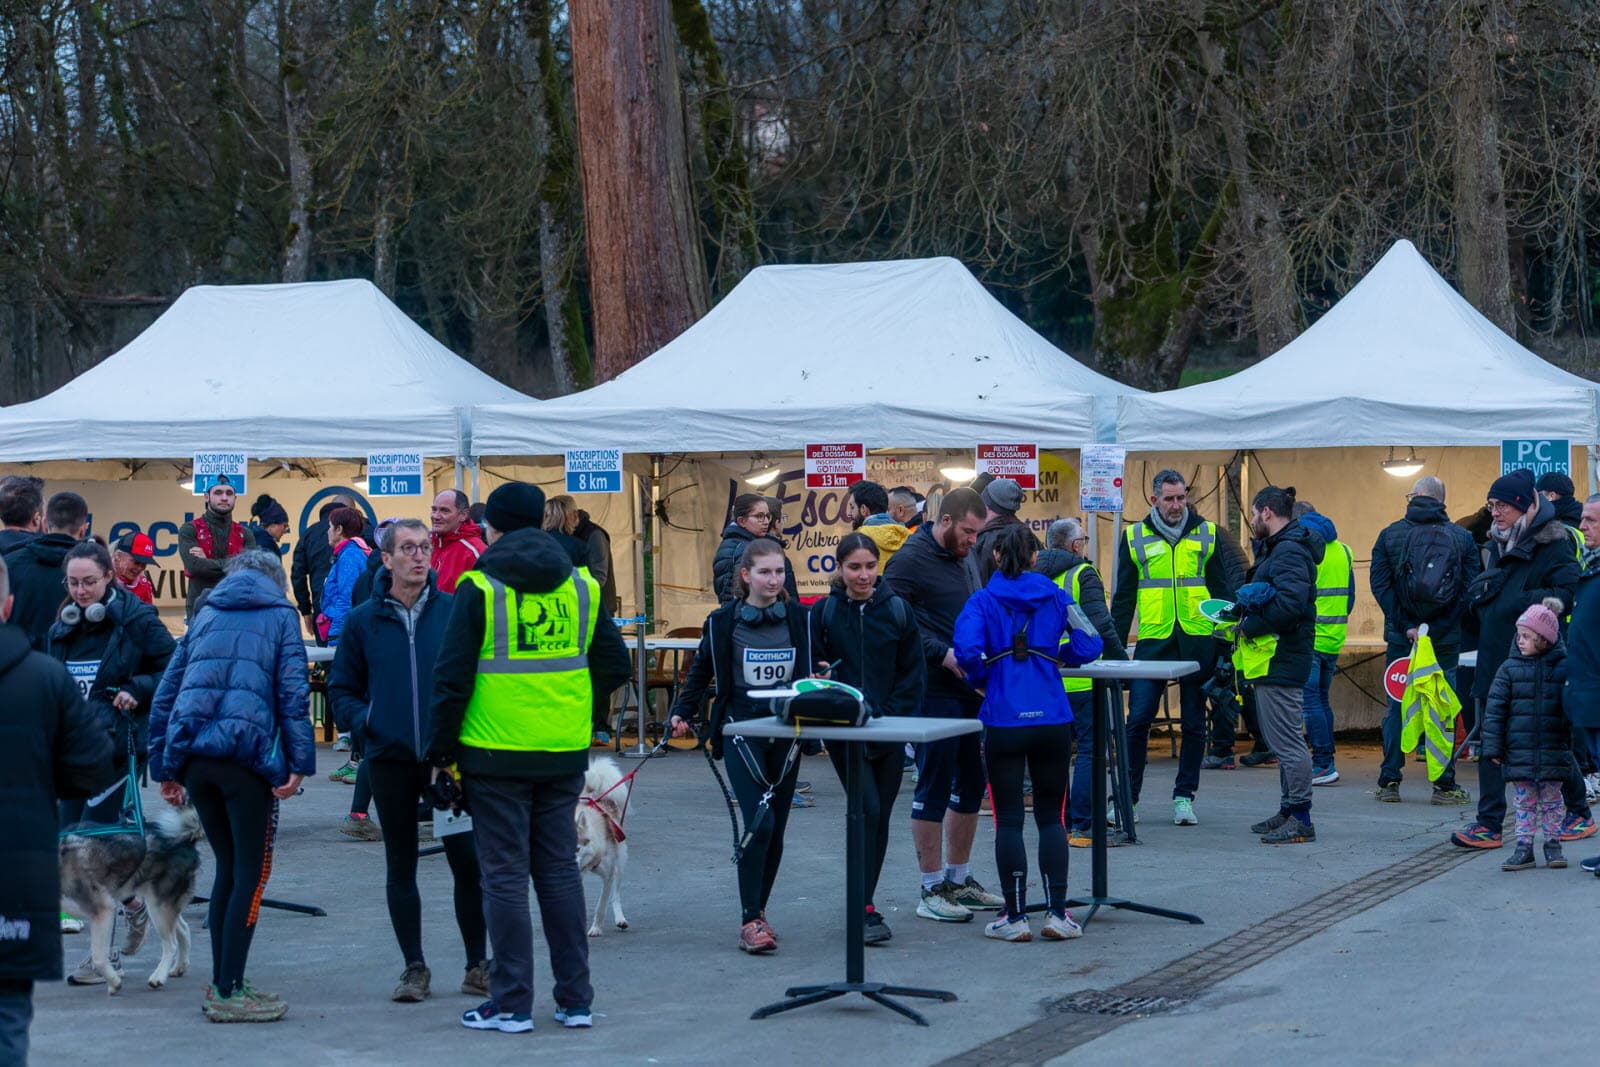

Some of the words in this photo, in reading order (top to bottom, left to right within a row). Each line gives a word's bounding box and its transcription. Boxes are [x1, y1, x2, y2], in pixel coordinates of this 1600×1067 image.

[567, 449, 620, 461] INSCRIPTIONS
[1517, 440, 1552, 462] PC
[196, 454, 245, 465] INSCRIPTIONS
[369, 454, 420, 465] INSCRIPTIONS
[569, 460, 617, 471] MARCHEURS
[200, 463, 240, 474] COUREURS
[816, 465, 854, 473] GOTIMING
[988, 466, 1026, 474] GOTIMING
[380, 477, 388, 494] 8
[390, 476, 409, 494] km
[579, 473, 587, 490] 8
[589, 472, 609, 490] km
[822, 474, 833, 487] 13
[833, 474, 848, 487] km
[1032, 488, 1060, 504] KM
[791, 529, 841, 552] Volkra
[752, 664, 786, 681] 190
